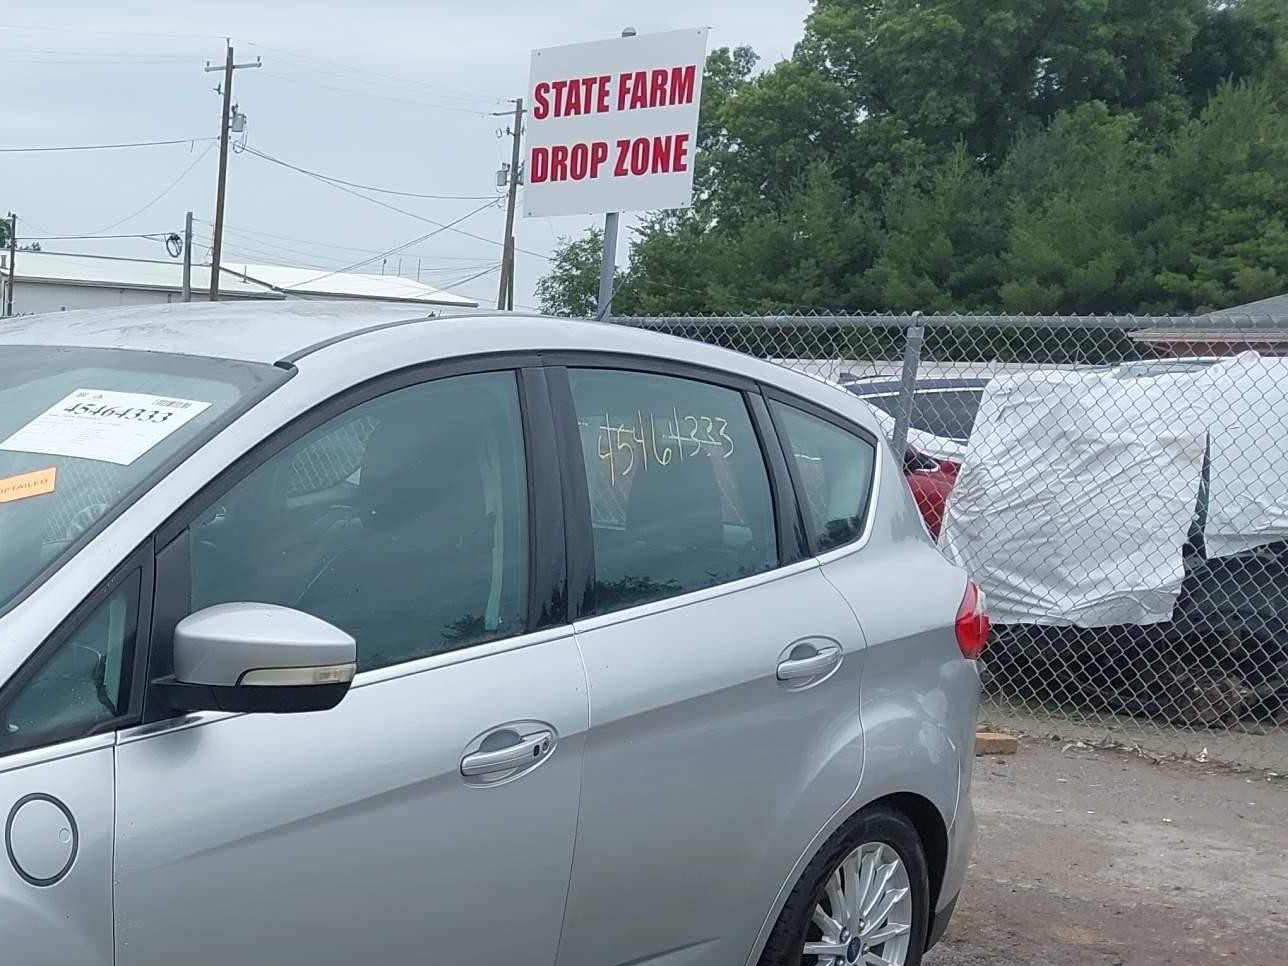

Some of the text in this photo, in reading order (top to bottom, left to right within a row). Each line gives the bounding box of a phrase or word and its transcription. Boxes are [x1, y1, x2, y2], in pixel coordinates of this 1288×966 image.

[533, 64, 697, 120] STATE FARM
[530, 133, 690, 184] DROP ZONE
[64, 402, 174, 424] 45464333
[598, 404, 735, 487] 45464333
